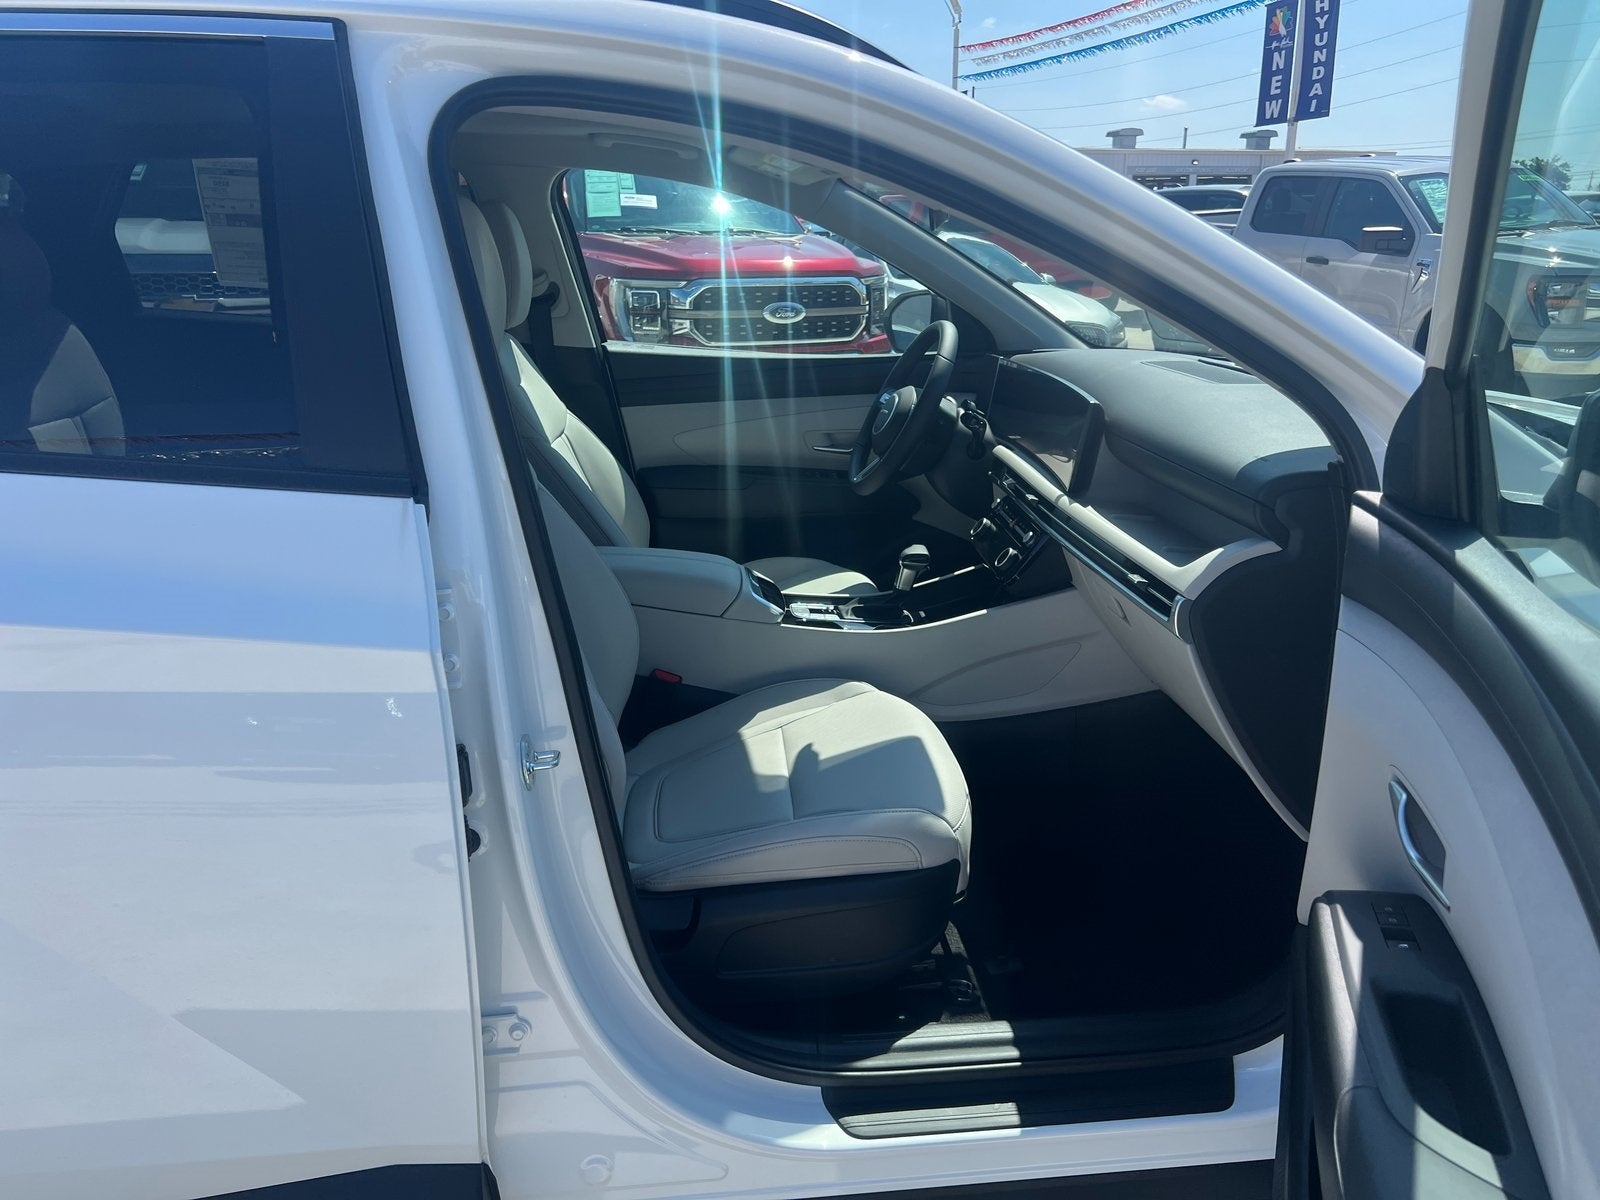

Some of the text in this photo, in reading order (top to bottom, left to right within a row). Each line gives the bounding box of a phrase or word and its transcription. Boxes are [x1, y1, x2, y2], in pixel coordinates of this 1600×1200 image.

[1265, 50, 1286, 120] NEW
[1308, 0, 1330, 113] HYUNDAI
[775, 307, 797, 318] Ford
